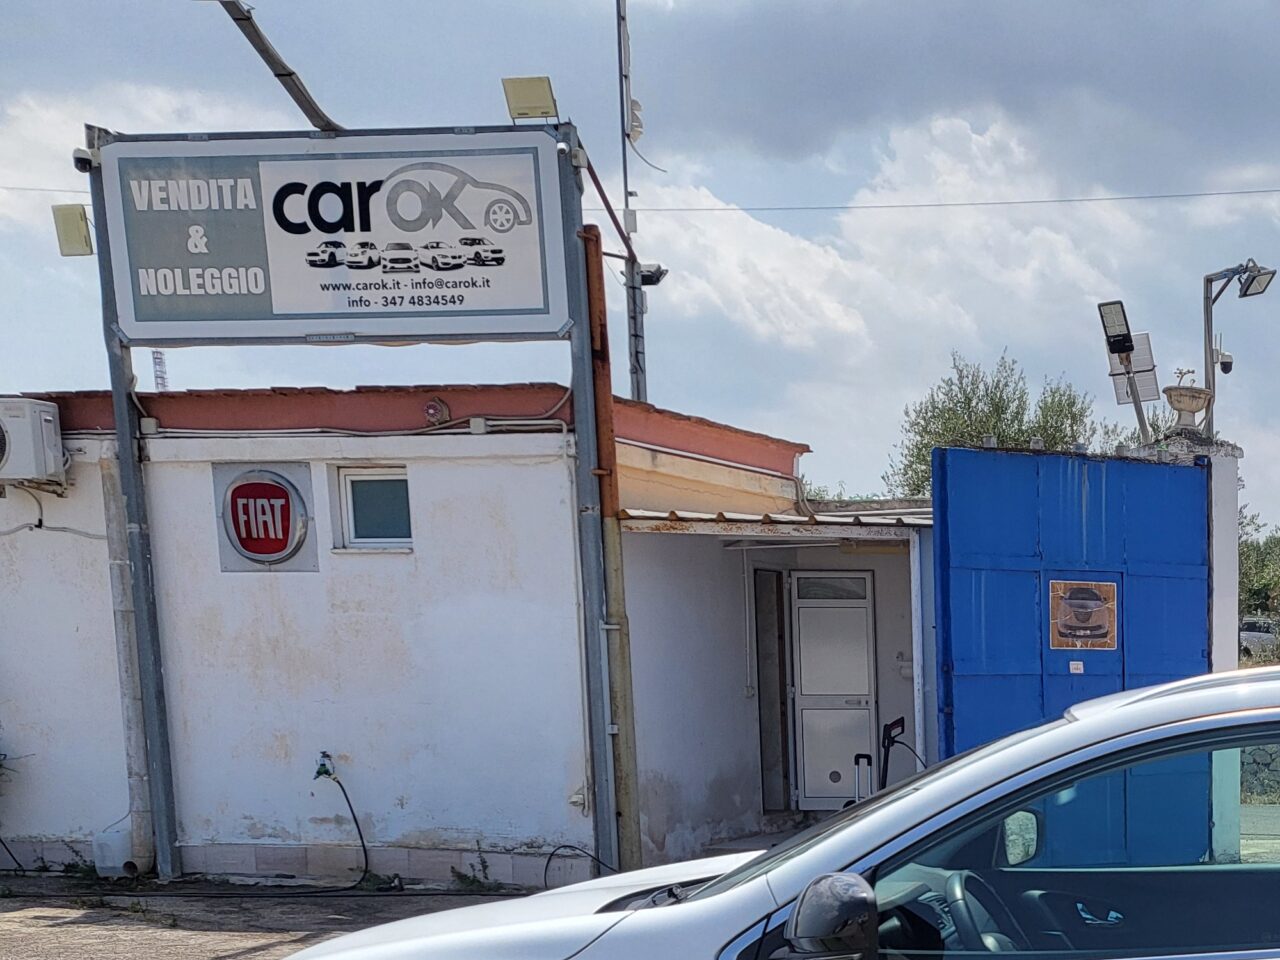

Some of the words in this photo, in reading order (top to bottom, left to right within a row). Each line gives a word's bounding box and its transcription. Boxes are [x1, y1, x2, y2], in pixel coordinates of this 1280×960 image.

[129, 178, 257, 211] VENDITA
[187, 224, 209, 254] &
[138, 266, 266, 296] NOLEGGIO
[319, 278, 401, 292] www.carok.it
[410, 276, 491, 291] info@carok.it
[347, 296, 371, 308] info
[381, 295, 405, 308] 347
[408, 294, 465, 307] 4834549
[236, 497, 286, 540] FIAT
